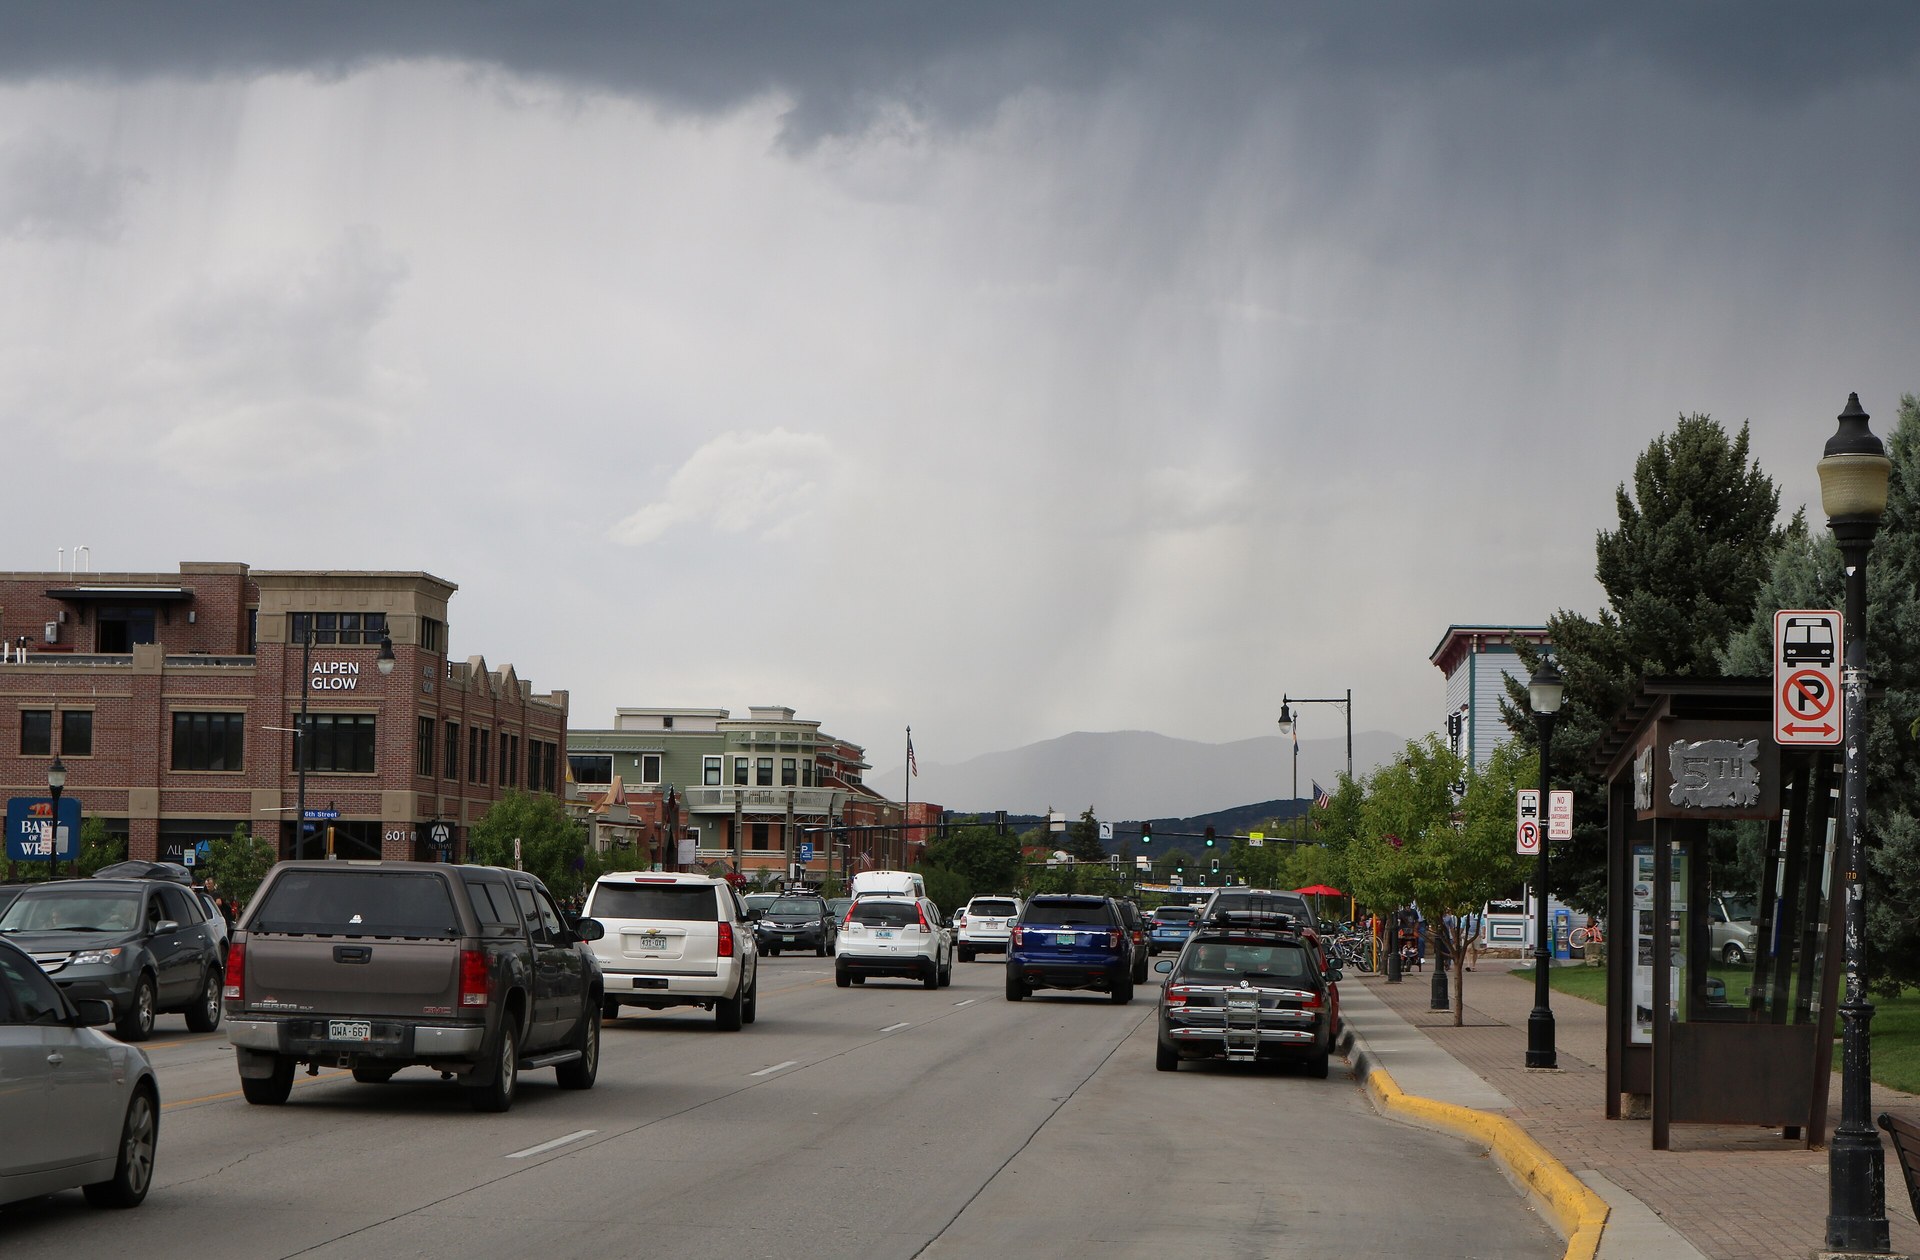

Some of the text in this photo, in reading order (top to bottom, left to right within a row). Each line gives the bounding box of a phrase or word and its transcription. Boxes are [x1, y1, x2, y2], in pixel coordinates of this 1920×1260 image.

[312, 662, 359, 674] ALPEN
[312, 677, 357, 690] GLOW
[1683, 756, 1744, 791] 5TH
[385, 831, 406, 841] 601
[167, 845, 182, 855] ALL
[423, 1006, 452, 1014] GMC
